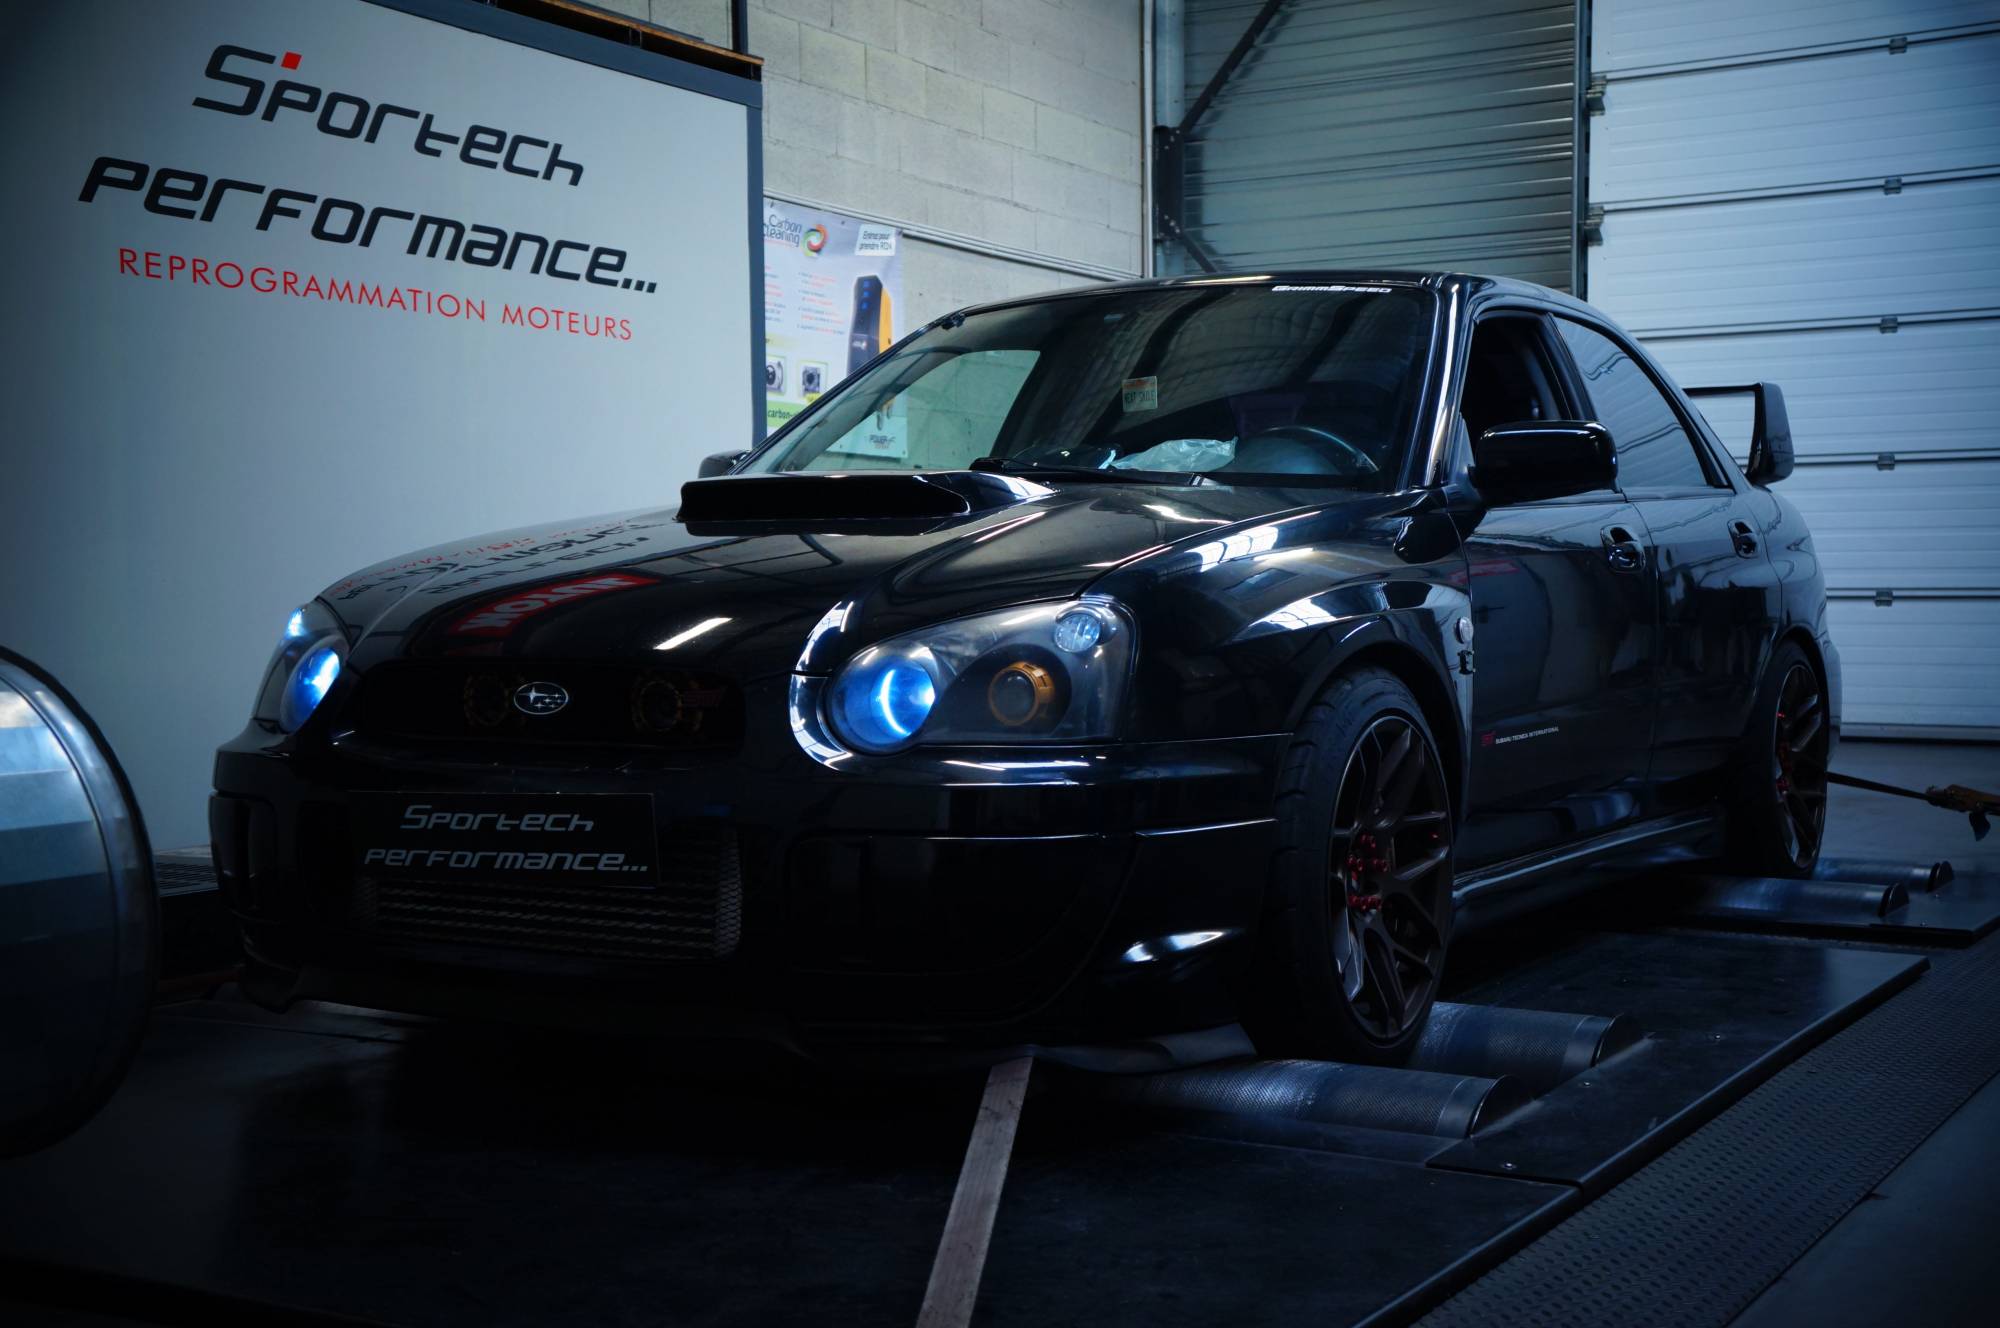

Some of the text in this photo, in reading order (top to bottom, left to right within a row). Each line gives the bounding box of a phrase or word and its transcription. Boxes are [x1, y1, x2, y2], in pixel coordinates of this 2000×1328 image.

[768, 214, 802, 234] Carbon
[119, 247, 633, 341] REPROGRAMMATION MOTEURS
